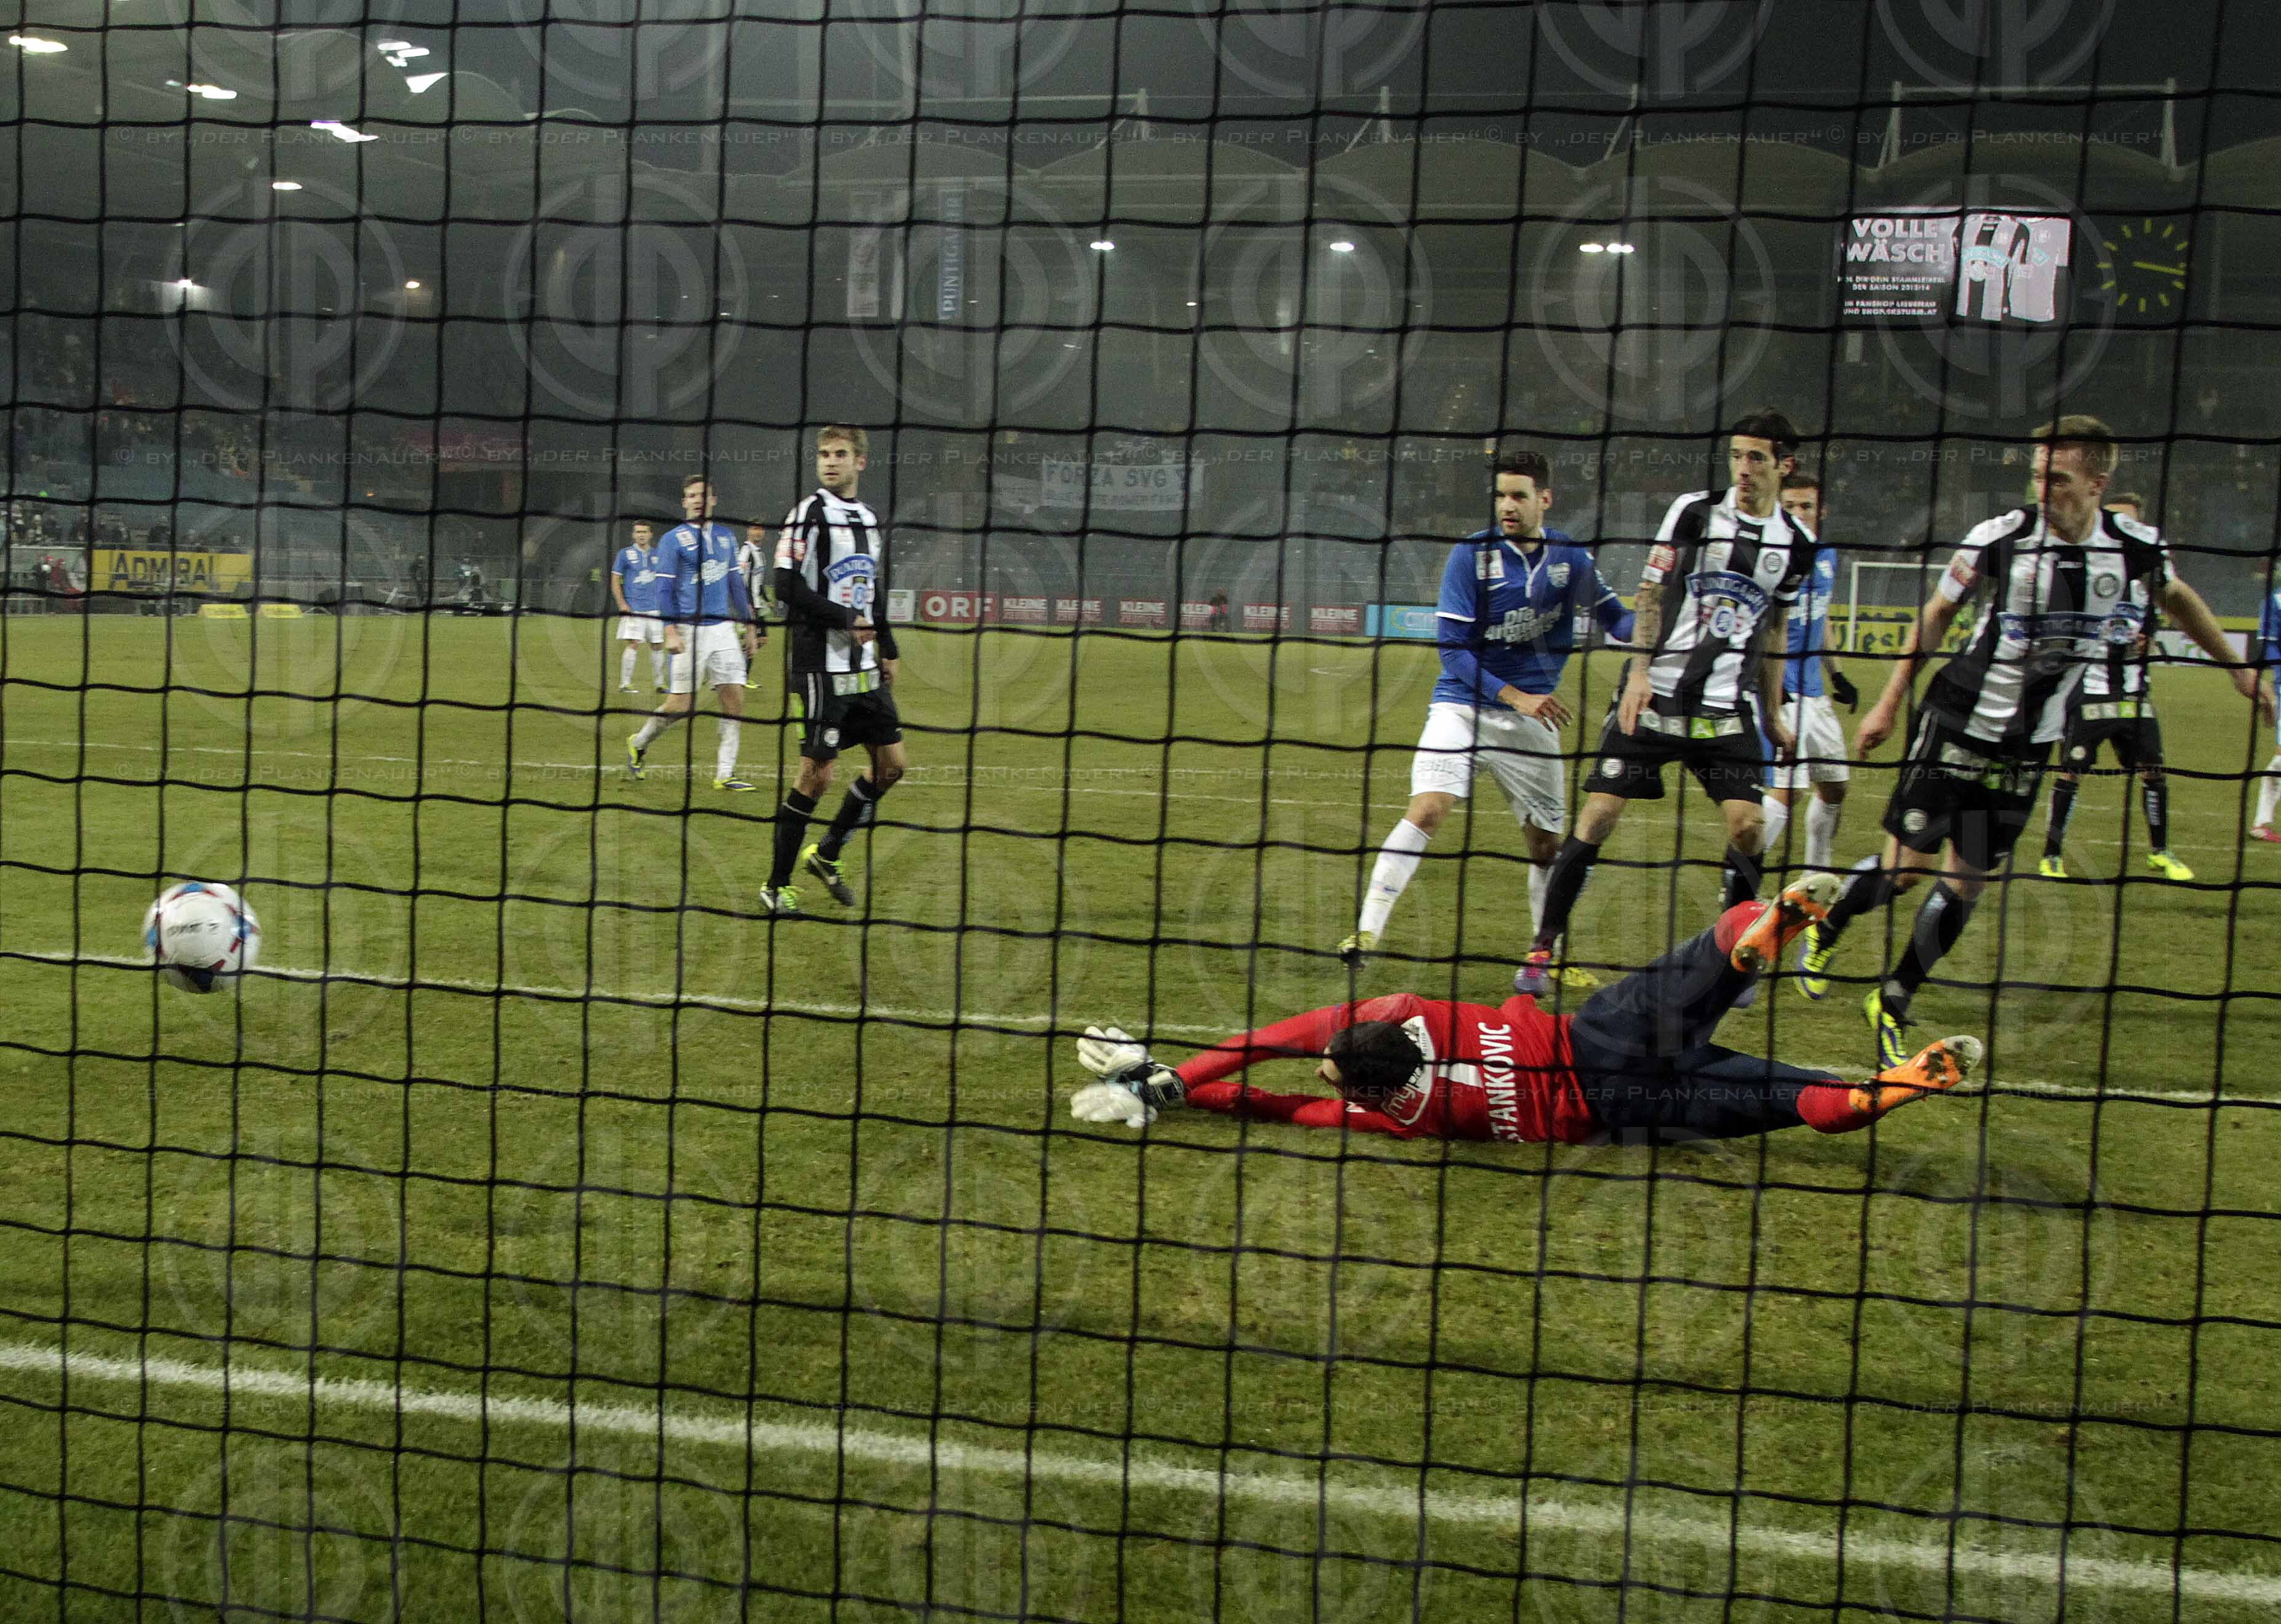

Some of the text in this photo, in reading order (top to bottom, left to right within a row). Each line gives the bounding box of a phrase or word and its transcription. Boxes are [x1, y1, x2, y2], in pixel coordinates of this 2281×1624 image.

[1851, 218, 1938, 239] VOLLE
[112, 552, 220, 588] ADMRAL
[925, 595, 993, 617] ORF
